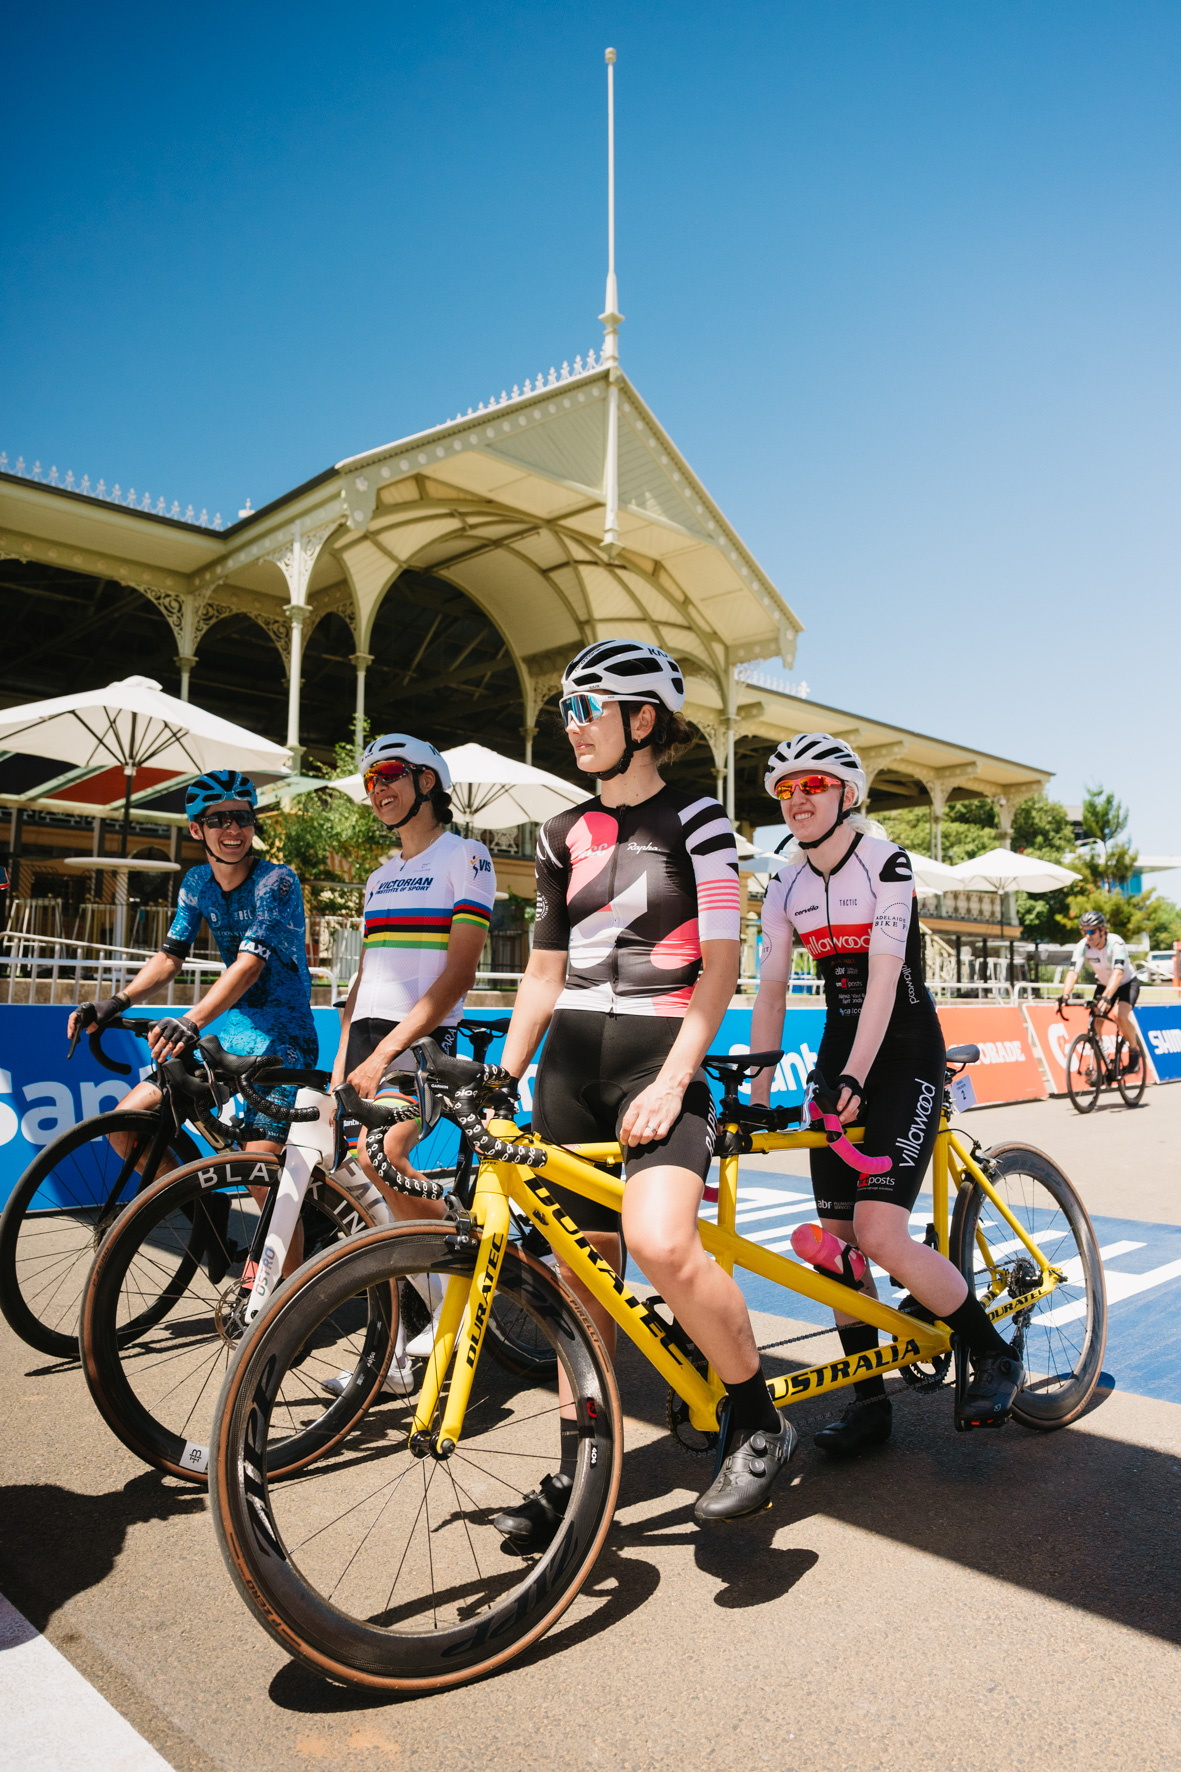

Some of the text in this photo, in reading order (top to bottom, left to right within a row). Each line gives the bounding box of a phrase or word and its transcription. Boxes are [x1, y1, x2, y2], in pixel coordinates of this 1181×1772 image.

[378, 877, 434, 890] VICTORIAN
[478, 859, 492, 873] VIS
[875, 920, 898, 928] BIKE
[876, 915, 906, 923] ADELAIDE
[895, 1078, 937, 1168] villawood
[198, 1162, 323, 1200] BLAK
[254, 1244, 277, 1297] OSTRO
[466, 1233, 505, 1369] DURATEC
[569, 1299, 600, 1344] PIRELLI
[767, 1338, 921, 1401] USTRALIA
